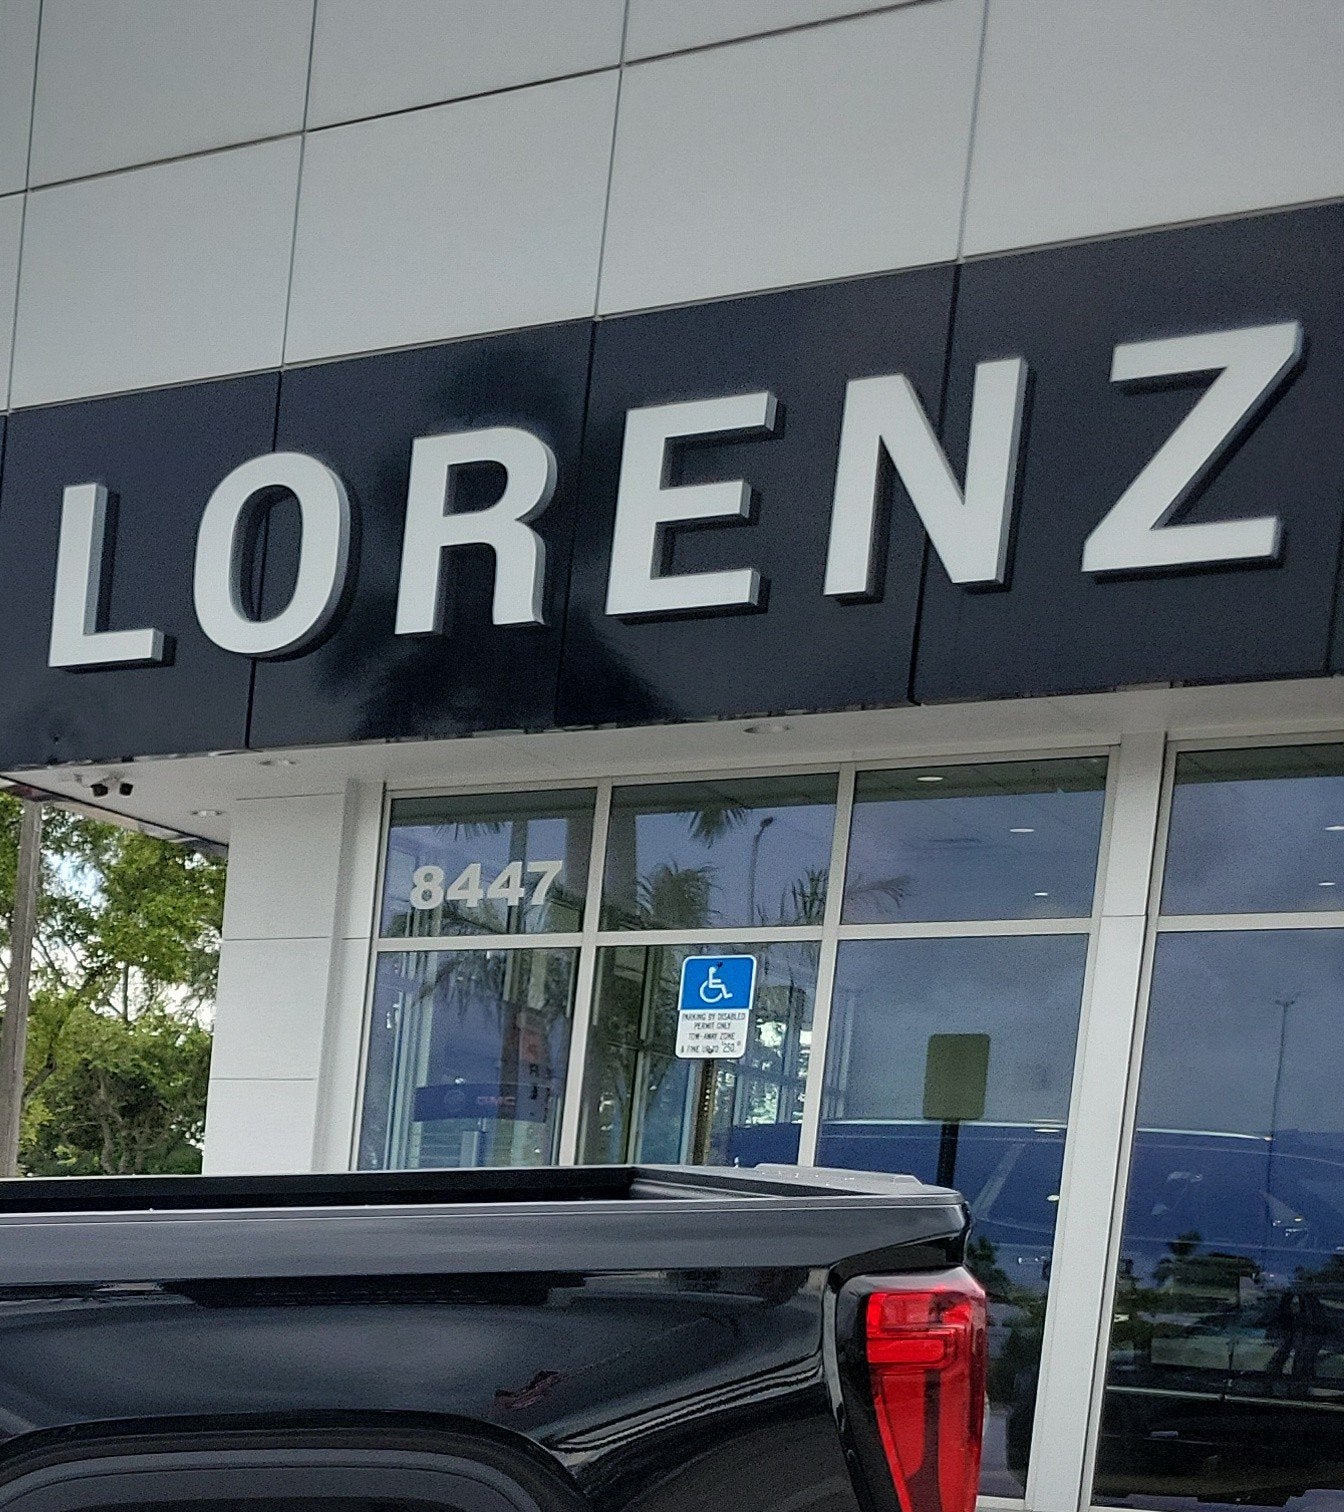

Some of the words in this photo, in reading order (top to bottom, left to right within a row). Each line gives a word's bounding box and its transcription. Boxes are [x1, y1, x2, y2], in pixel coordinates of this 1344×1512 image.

[49, 320, 1304, 669] LORENZ
[410, 859, 563, 910] 8447
[682, 1013, 706, 1021] PARKING
[708, 1013, 716, 1021] BY
[717, 1012, 746, 1021] DISABLED
[693, 1022, 715, 1030] PERMIT
[716, 1021, 731, 1030] ONLY
[688, 1032, 718, 1041] TOW-AWAY
[719, 1032, 735, 1040] ZONE
